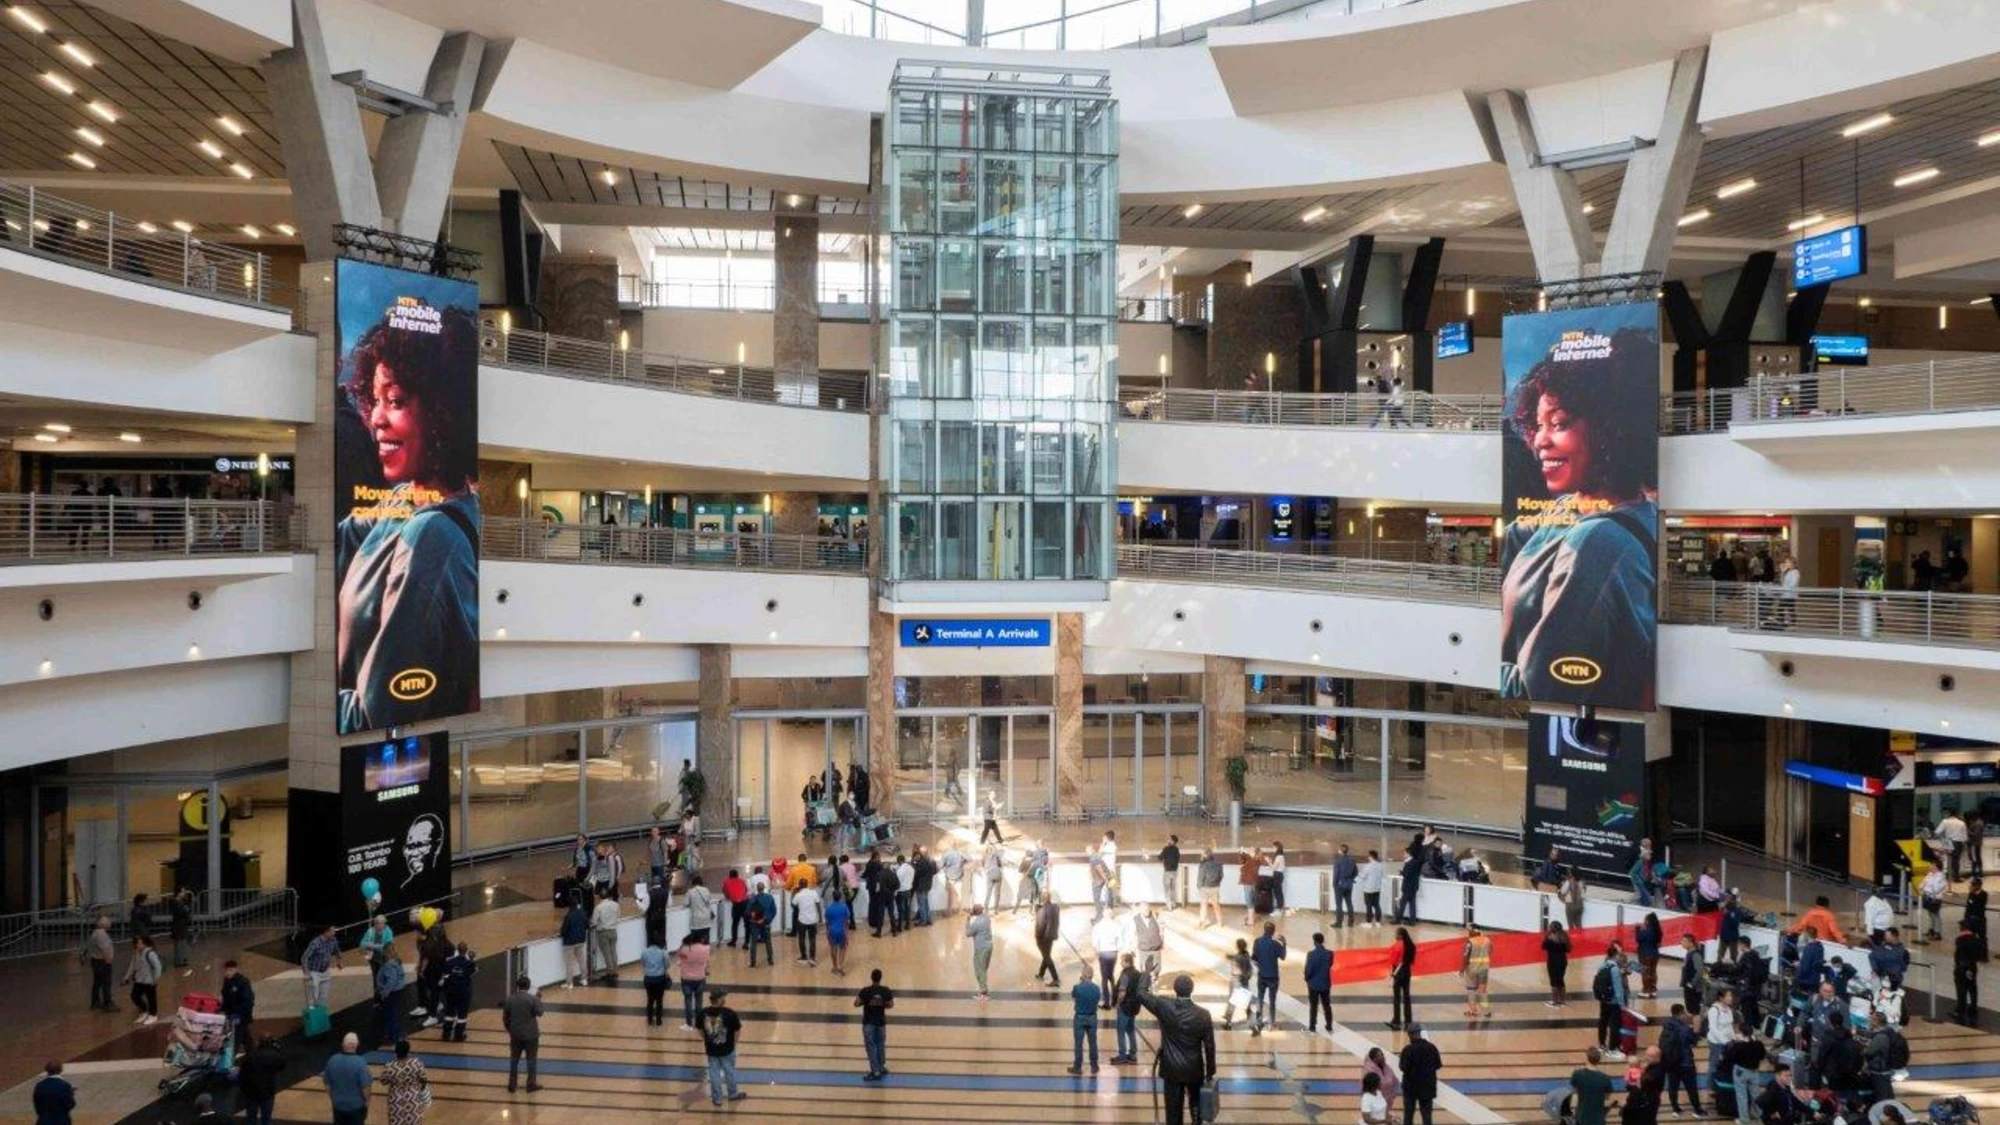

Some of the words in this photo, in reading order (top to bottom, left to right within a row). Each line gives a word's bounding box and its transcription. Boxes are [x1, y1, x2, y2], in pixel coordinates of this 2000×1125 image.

[396, 305, 441, 321] mobile
[389, 314, 442, 334] internet
[1561, 335, 1611, 350] mobile
[1553, 347, 1613, 362] internet
[232, 461, 291, 470] NEDANK
[937, 628, 982, 639] Terminal
[986, 628, 994, 638] A
[998, 628, 1039, 639] Arrivals
[1562, 664, 1590, 676] MTN
[400, 678, 426, 691] MTN
[1562, 758, 1607, 772] SAMSUNG
[377, 784, 420, 801] SAMSUNG
[364, 847, 391, 860] Tambo
[363, 857, 387, 870] YEARS
